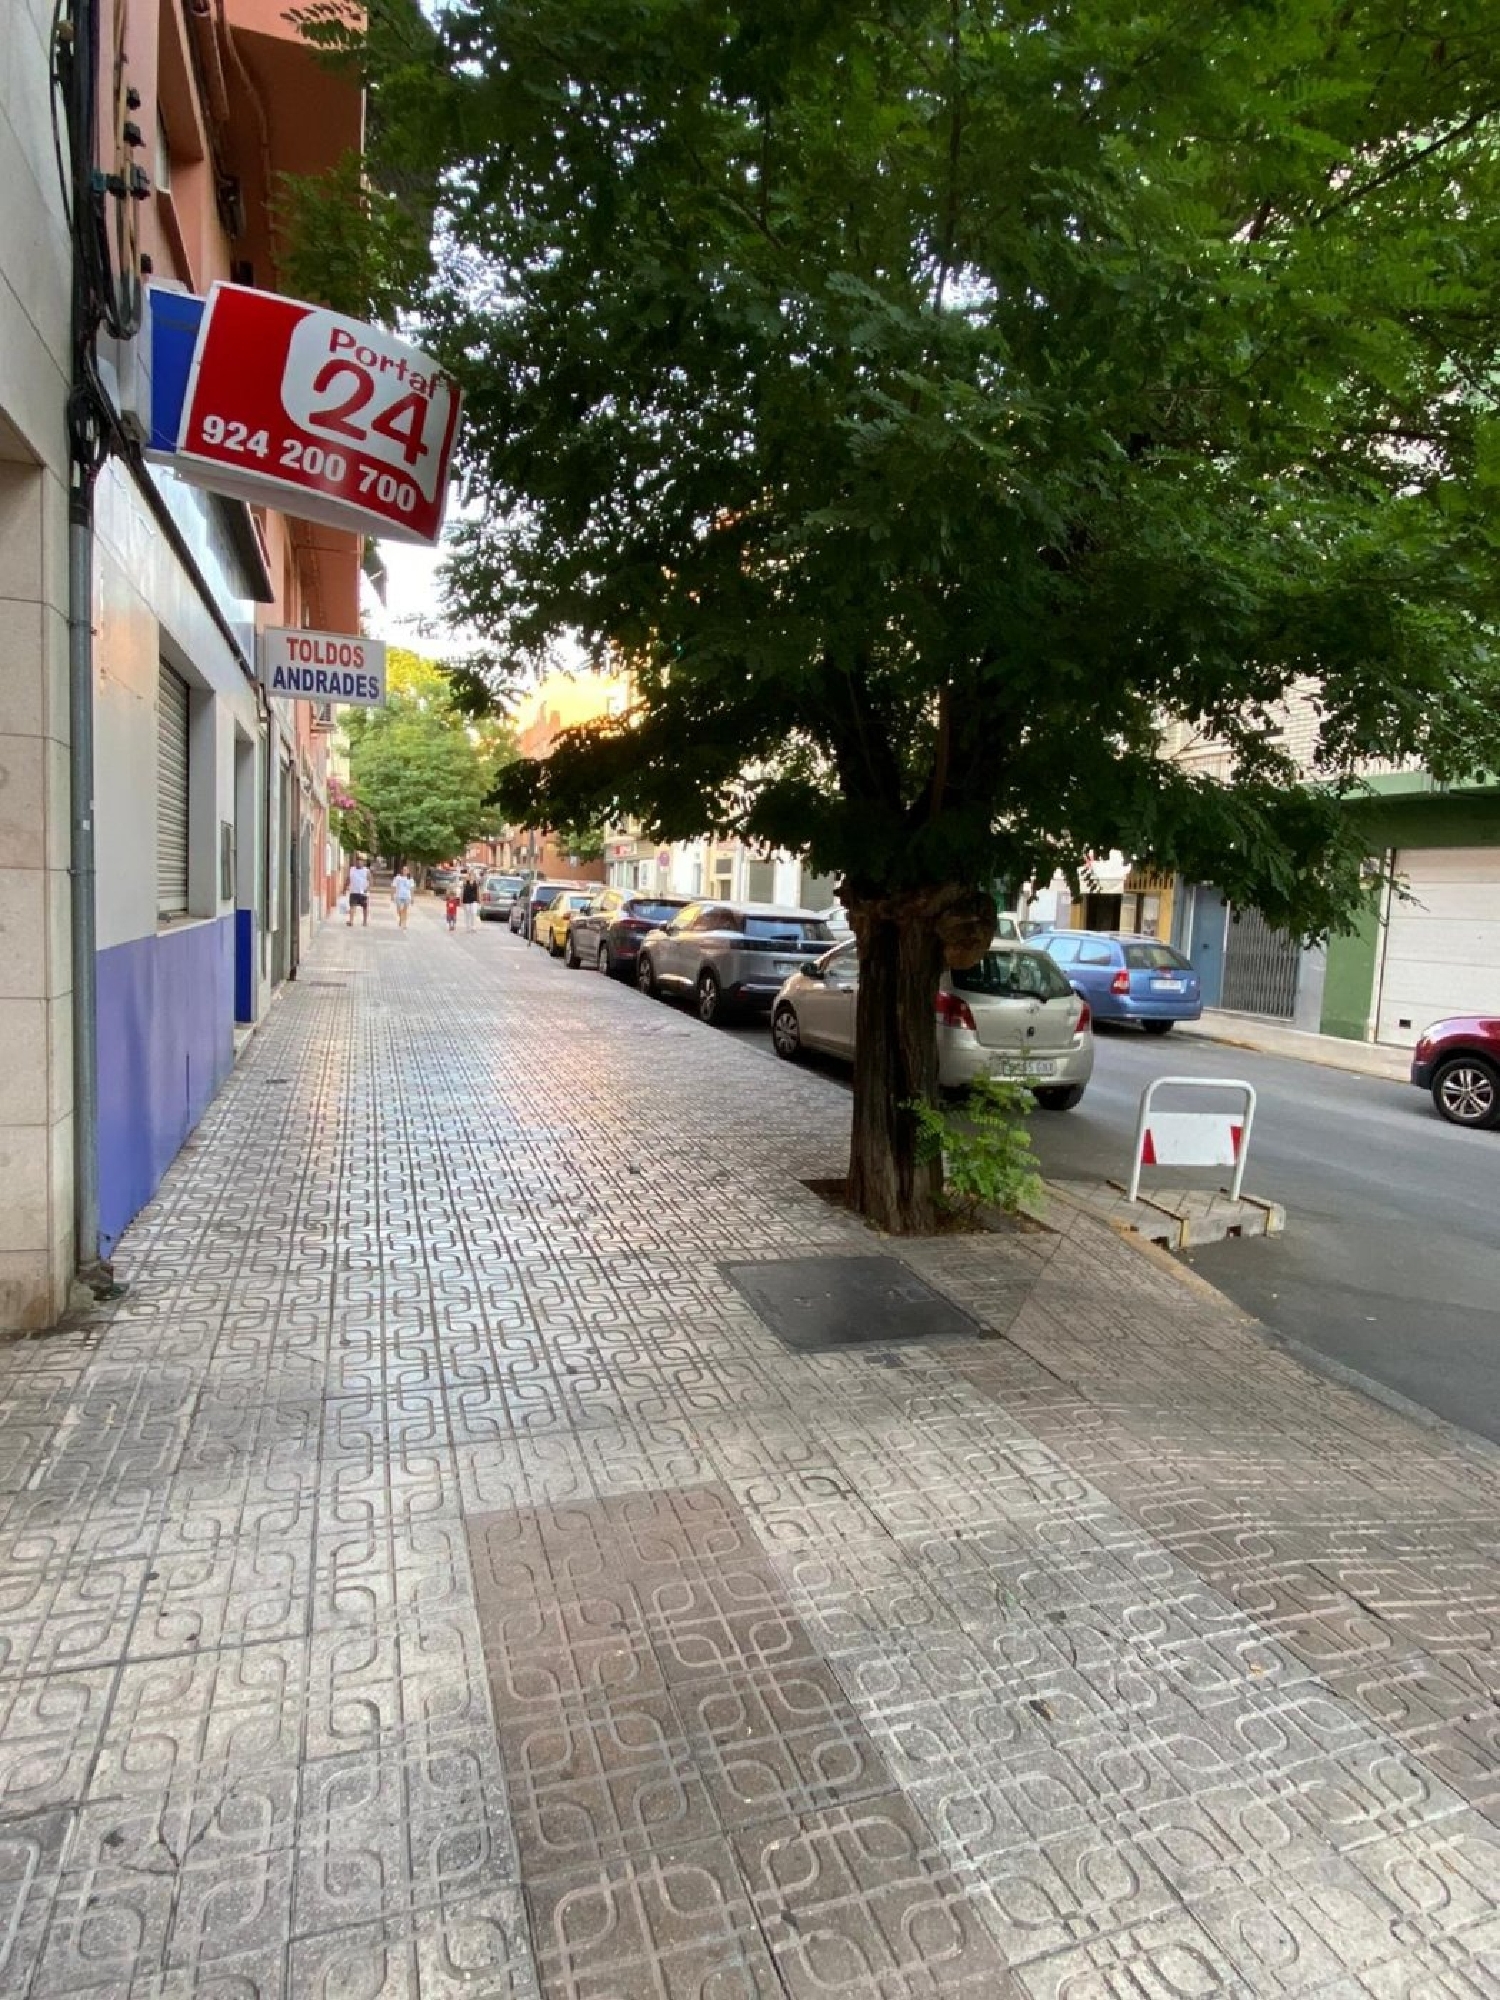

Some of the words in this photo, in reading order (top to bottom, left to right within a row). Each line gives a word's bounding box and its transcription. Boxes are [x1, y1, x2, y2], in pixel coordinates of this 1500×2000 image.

[308, 358, 428, 466] 24
[202, 415, 270, 458] 924
[279, 438, 347, 482] 200
[358, 465, 417, 513] 700
[273, 666, 380, 699] ANDRADES
[286, 637, 365, 669] TOLDOS
